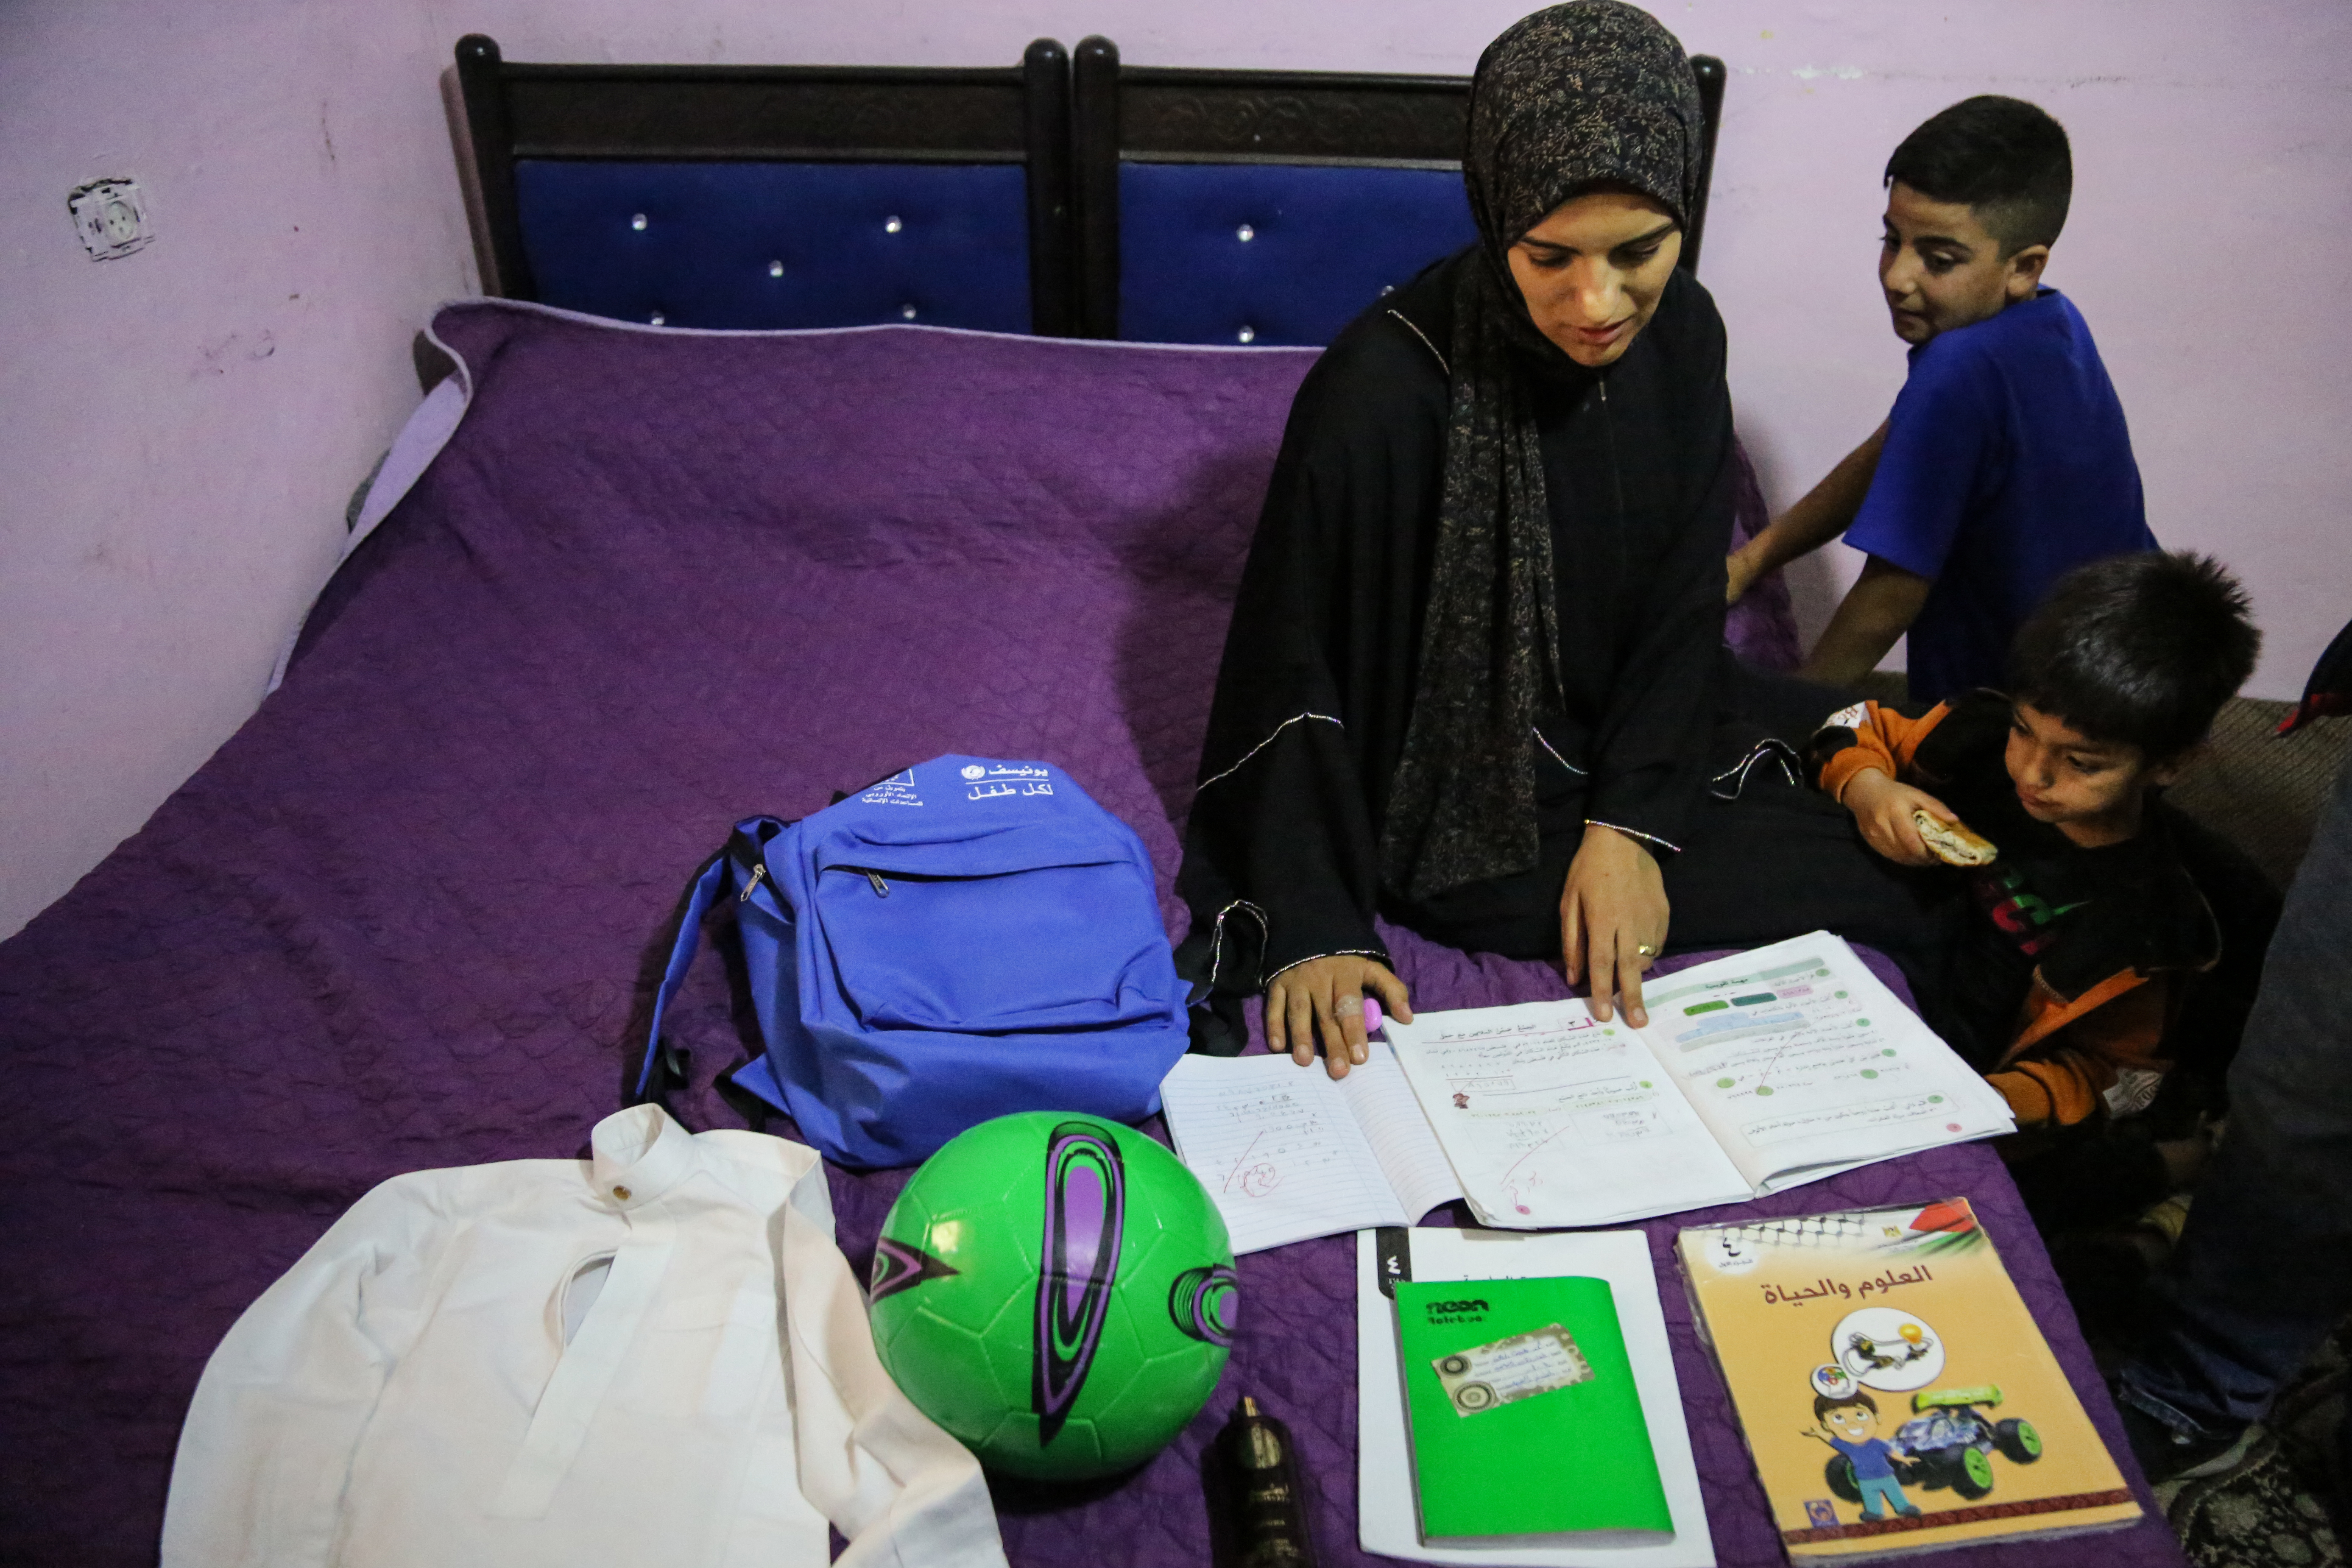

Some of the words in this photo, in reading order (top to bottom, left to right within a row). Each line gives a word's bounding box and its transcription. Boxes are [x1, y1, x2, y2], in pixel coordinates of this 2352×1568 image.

[988, 764, 1049, 776] يونيسف
[968, 784, 1016, 800] طفل
[1022, 783, 1053, 795] لكل
[1723, 1237, 1741, 1257] ٤
[1858, 1264, 1933, 1300] العلوم
[1760, 1278, 1852, 1307] والحياة
